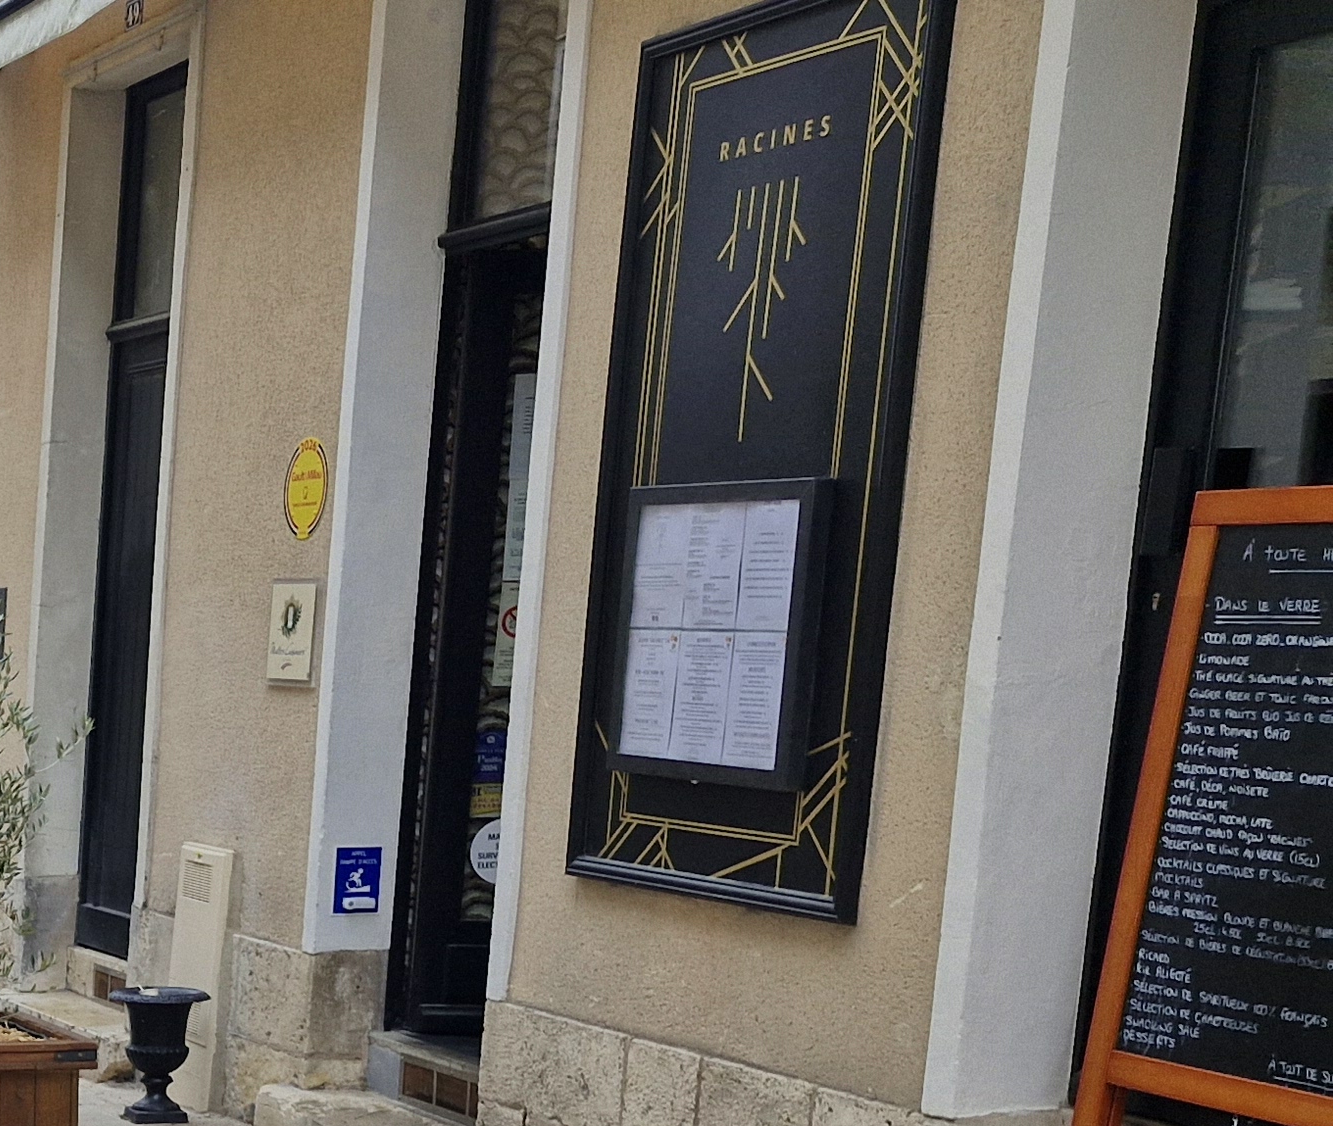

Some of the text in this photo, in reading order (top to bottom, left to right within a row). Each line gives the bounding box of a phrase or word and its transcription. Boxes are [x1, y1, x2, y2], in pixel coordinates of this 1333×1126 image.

[719, 115, 831, 162] RACINES
[1214, 596, 1321, 612] DANS LE VERRE
[1198, 653, 1250, 666] LIMONADE
[1189, 688, 1221, 700] GINGER
[1225, 690, 1251, 702] BEER
[1188, 706, 1205, 717] JUS
[1209, 708, 1221, 719] DE
[1183, 722, 1201, 735] JUS
[1204, 726, 1215, 736] DE
[1220, 724, 1259, 739] POMMES
[1181, 740, 1205, 756] CAFÉ
[1170, 792, 1193, 806] CAFÉ
[1164, 822, 1202, 836] CHOCOLAT
[1205, 828, 1233, 840] CHAUD
[1256, 848, 1284, 863] VERRE
[1157, 856, 1203, 873] COCKTAILS
[1155, 871, 1203, 888] MOCKTAILS
[1151, 886, 1170, 900] BAR
[1184, 890, 1219, 908] SPRITZ
[1138, 948, 1170, 963] RICARD
[1179, 1010, 1191, 1021] DE
[1181, 990, 1193, 1002] DE
[1280, 1006, 1329, 1029] FRANÇAIS
[1122, 1029, 1176, 1049] DESSERTS
[1306, 1068, 1318, 1083] DE
